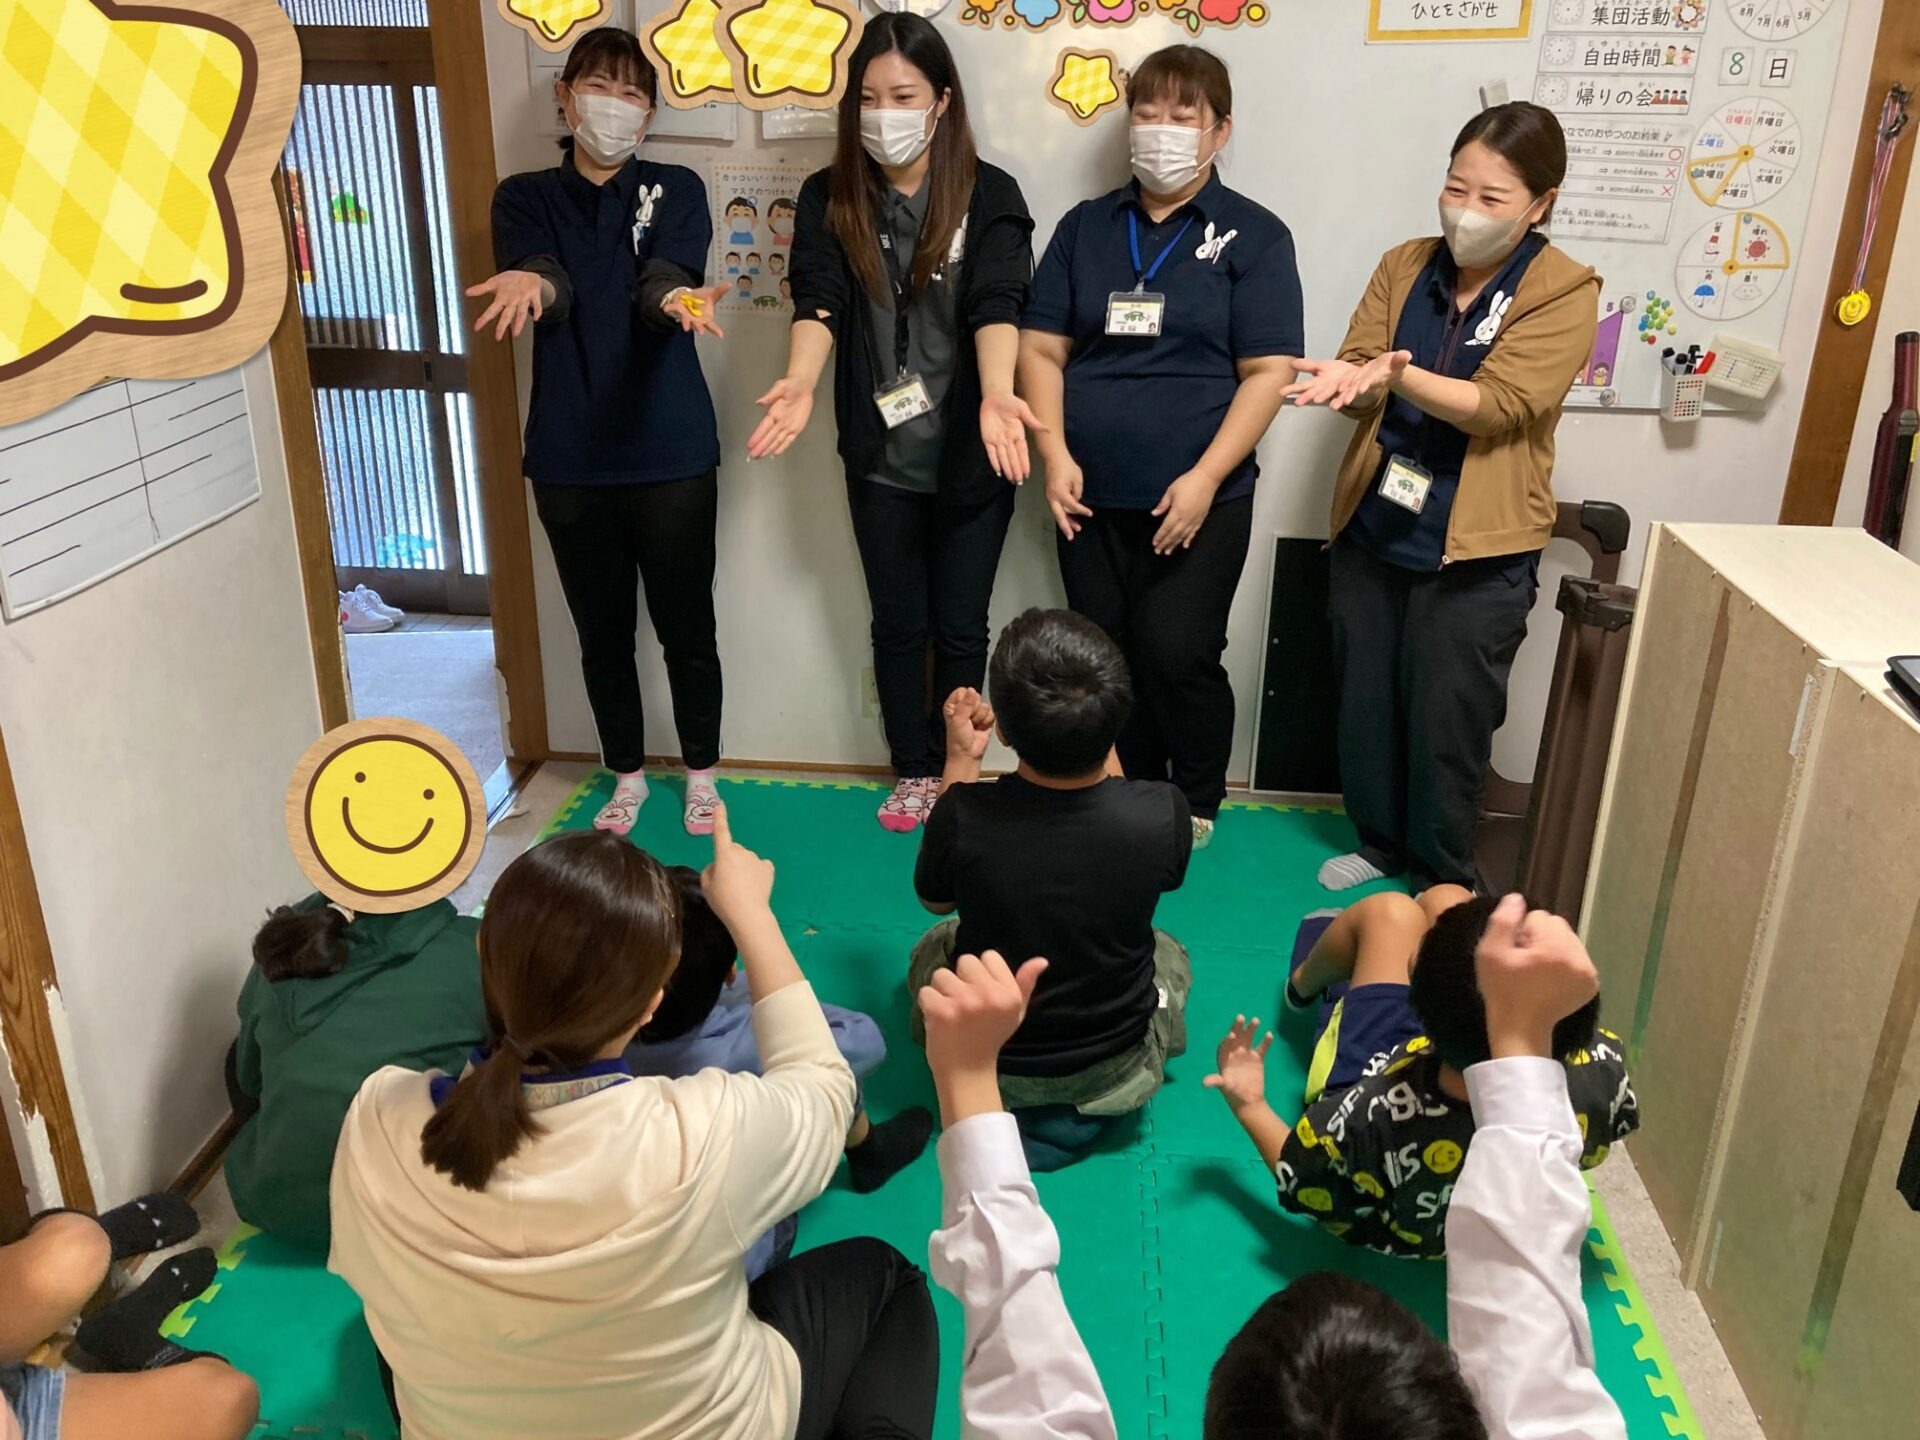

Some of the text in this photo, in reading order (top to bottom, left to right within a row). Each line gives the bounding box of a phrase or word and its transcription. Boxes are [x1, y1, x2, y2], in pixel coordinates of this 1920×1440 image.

[1411, 1, 1499, 20] ひとをさがせ
[1740, 7, 1754, 17] 8月
[1591, 6, 1671, 26] 集団活動
[1797, 11, 1811, 21] 5月
[1757, 17, 1771, 27] 7月
[1776, 18, 1790, 28] 6月
[1584, 47, 1662, 67] 自由時間
[1729, 52, 1788, 79] 8 日
[1576, 87, 1654, 108] 帰りの会
[1725, 115, 1752, 125] 日曜日
[1756, 116, 1783, 127] 月曜日
[1563, 127, 1660, 141] なでのおやつのお約束
[1697, 138, 1724, 148] 土曜日
[1768, 145, 1796, 155] 火曜日
[1756, 175, 1783, 185] 水曜日
[1722, 188, 1748, 198] 木曜日
